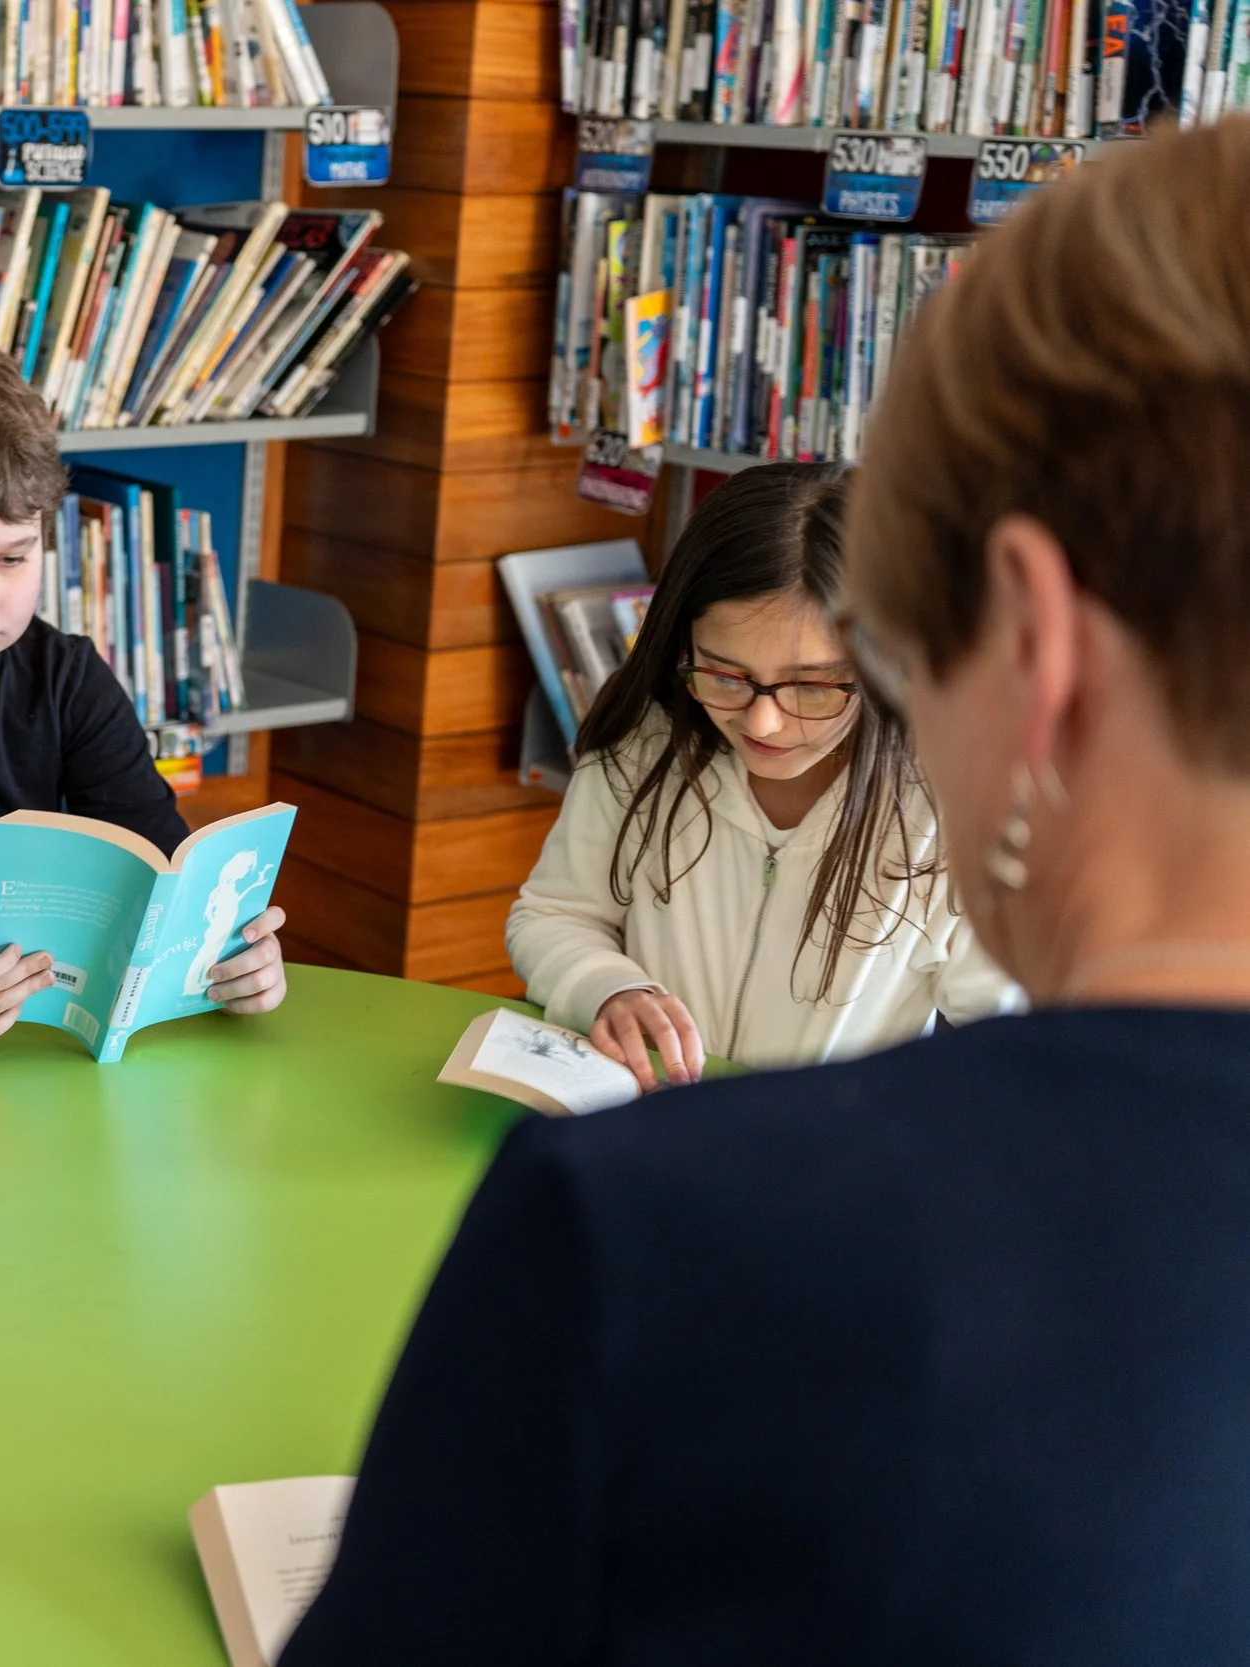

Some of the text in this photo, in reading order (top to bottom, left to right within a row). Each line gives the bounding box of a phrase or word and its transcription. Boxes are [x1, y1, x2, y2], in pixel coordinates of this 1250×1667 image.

[1, 112, 88, 142] 500-599
[308, 111, 347, 146] 510
[830, 137, 878, 173] 530
[977, 143, 1031, 181] 550
[25, 161, 84, 183] SCIENCE
[838, 190, 900, 217] PHYSICS
